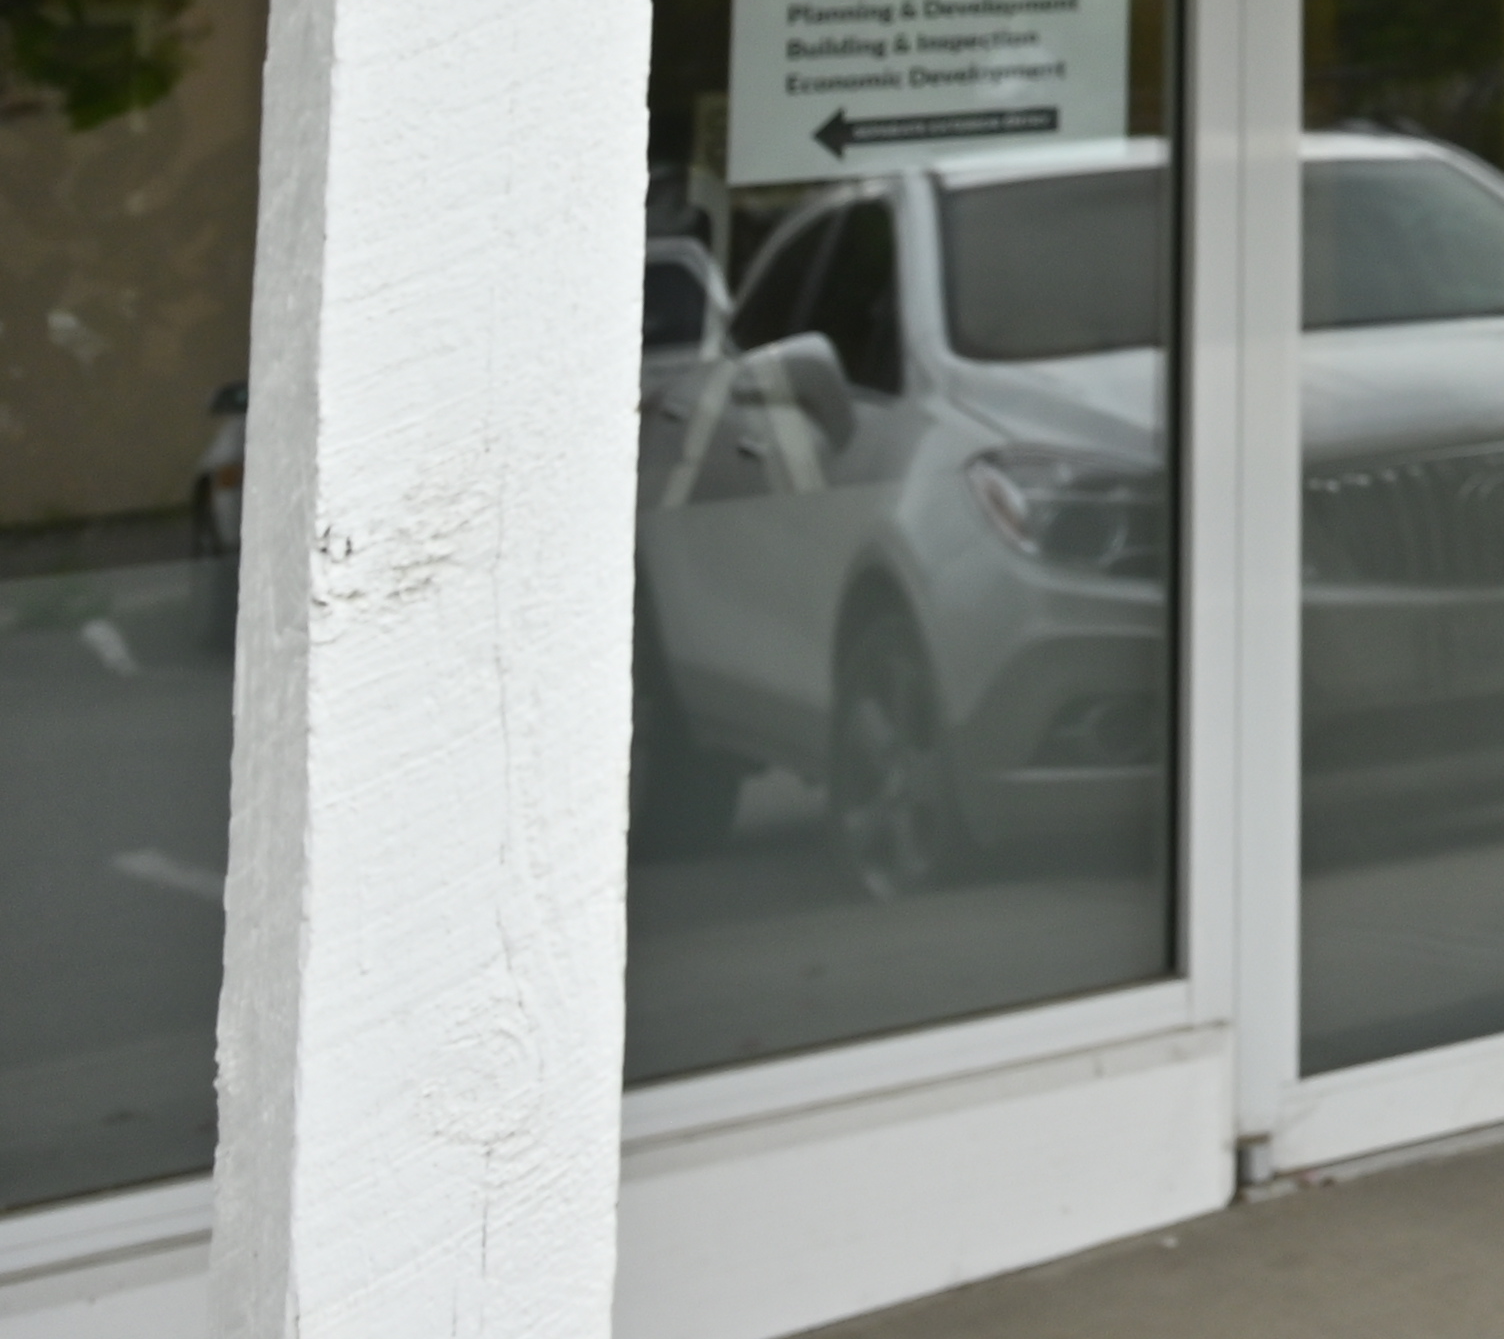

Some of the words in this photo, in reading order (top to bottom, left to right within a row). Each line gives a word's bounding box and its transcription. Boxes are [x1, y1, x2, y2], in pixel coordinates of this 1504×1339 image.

[787, 3, 894, 26] Planning
[787, 36, 887, 61] Building
[917, 29, 1039, 55] Inspection
[786, 69, 902, 96] Economic
